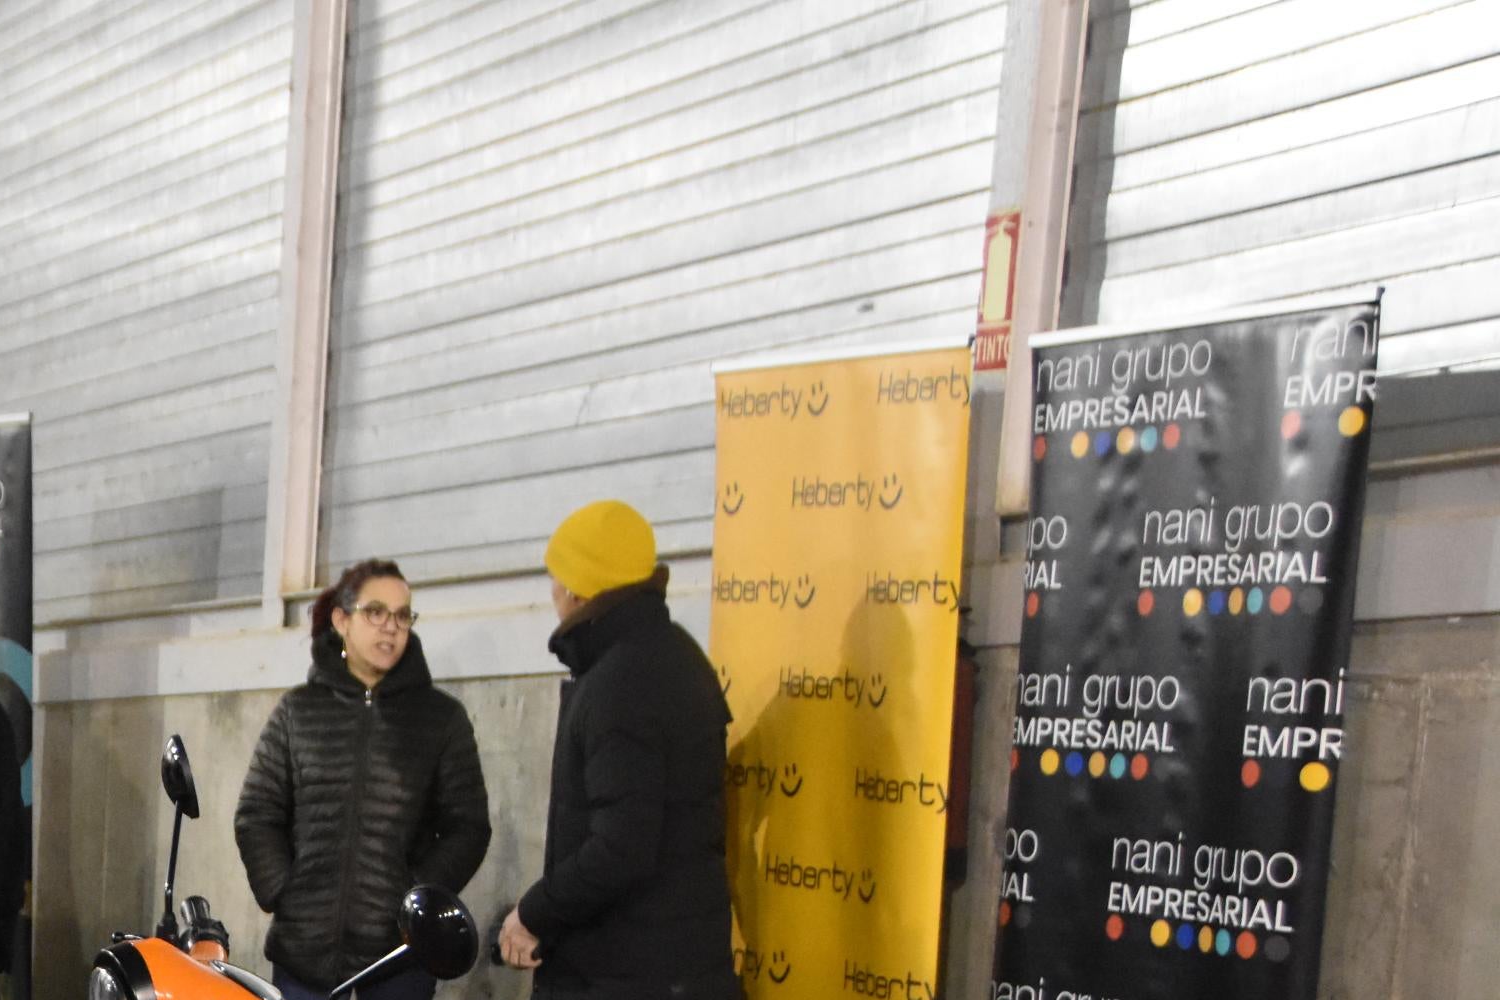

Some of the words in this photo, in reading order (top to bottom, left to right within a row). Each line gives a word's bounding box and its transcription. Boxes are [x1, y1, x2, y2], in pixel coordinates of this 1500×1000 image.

[878, 367, 970, 407] Heberty
[1036, 344, 1102, 393] nani
[1112, 339, 1212, 393] grupo
[1284, 369, 1378, 408] EMPR
[720, 382, 802, 421] Heberty
[1034, 387, 1206, 434] EMPRESARIAL
[791, 473, 875, 511] Heberty
[1143, 496, 1215, 545] nani
[1225, 501, 1333, 552] grupo
[866, 570, 960, 612] Heberty
[1139, 551, 1328, 588] EMPRESARIAL
[779, 665, 865, 707] Heberty
[1083, 674, 1180, 719] grupo
[1246, 667, 1345, 715] nani
[1243, 724, 1344, 760] EMPR
[855, 767, 948, 814] Heberty
[765, 852, 854, 901] Heberty
[1111, 832, 1184, 877] nani
[1194, 844, 1298, 893] grupo
[1107, 882, 1293, 932] EMPRESARIAL
